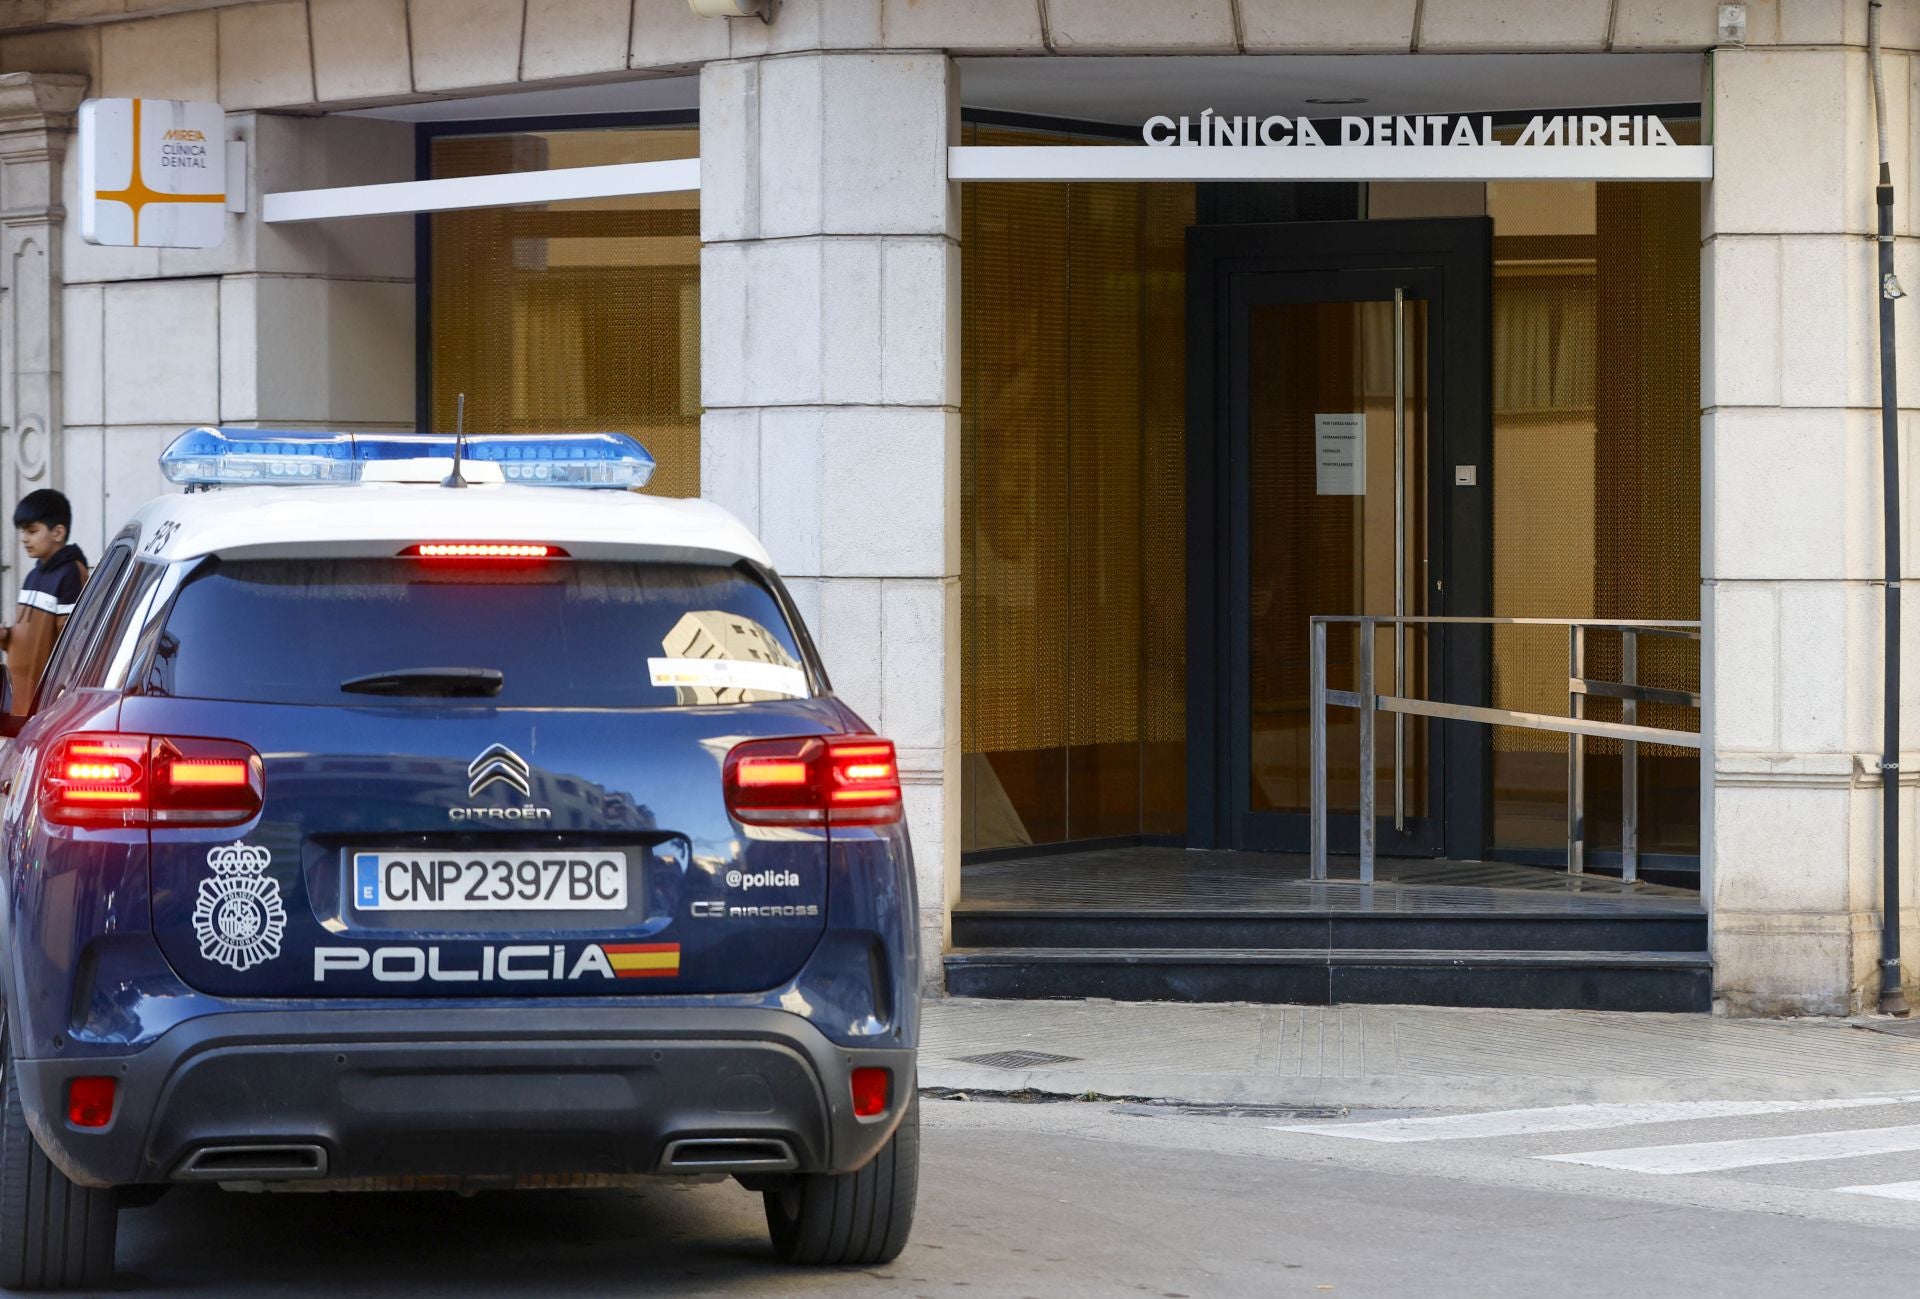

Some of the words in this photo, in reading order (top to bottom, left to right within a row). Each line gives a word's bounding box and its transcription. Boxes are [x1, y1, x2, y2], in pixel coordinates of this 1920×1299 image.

[1142, 107, 1327, 147] CLÍNICA
[1340, 115, 1502, 146] DENTAL
[1513, 114, 1678, 146] MIREIA
[162, 129, 206, 142] MIREIA
[161, 143, 206, 156] CLÍNICA
[161, 157, 206, 168] DENTAL
[384, 860, 619, 902] CNP2397BC
[725, 870, 800, 891] @policia
[363, 886, 374, 899] E
[730, 905, 818, 917] AIRCROSS
